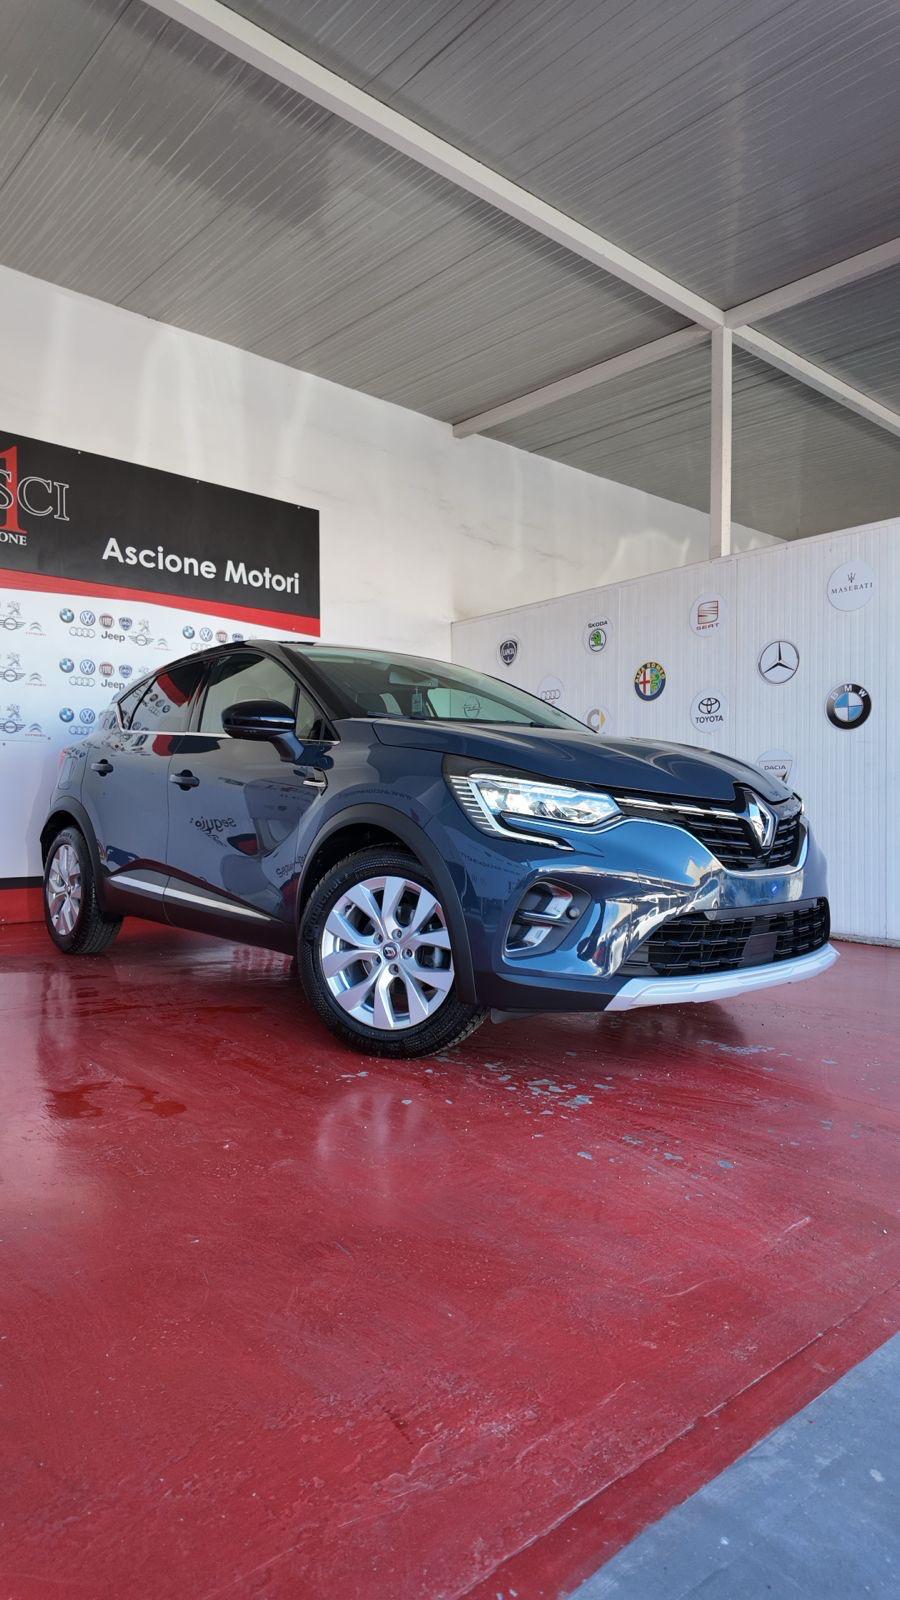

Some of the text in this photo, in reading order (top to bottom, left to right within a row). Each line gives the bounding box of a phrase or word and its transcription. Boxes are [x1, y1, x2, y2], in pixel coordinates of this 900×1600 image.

[102, 537, 300, 595] Ascione Motori
[831, 582, 873, 594] MASERATI
[695, 622, 720, 631] SEAT
[101, 631, 126, 642] Jeep
[100, 679, 126, 691] Jeep
[830, 684, 868, 701] BMW
[695, 715, 724, 724] TOYOTA
